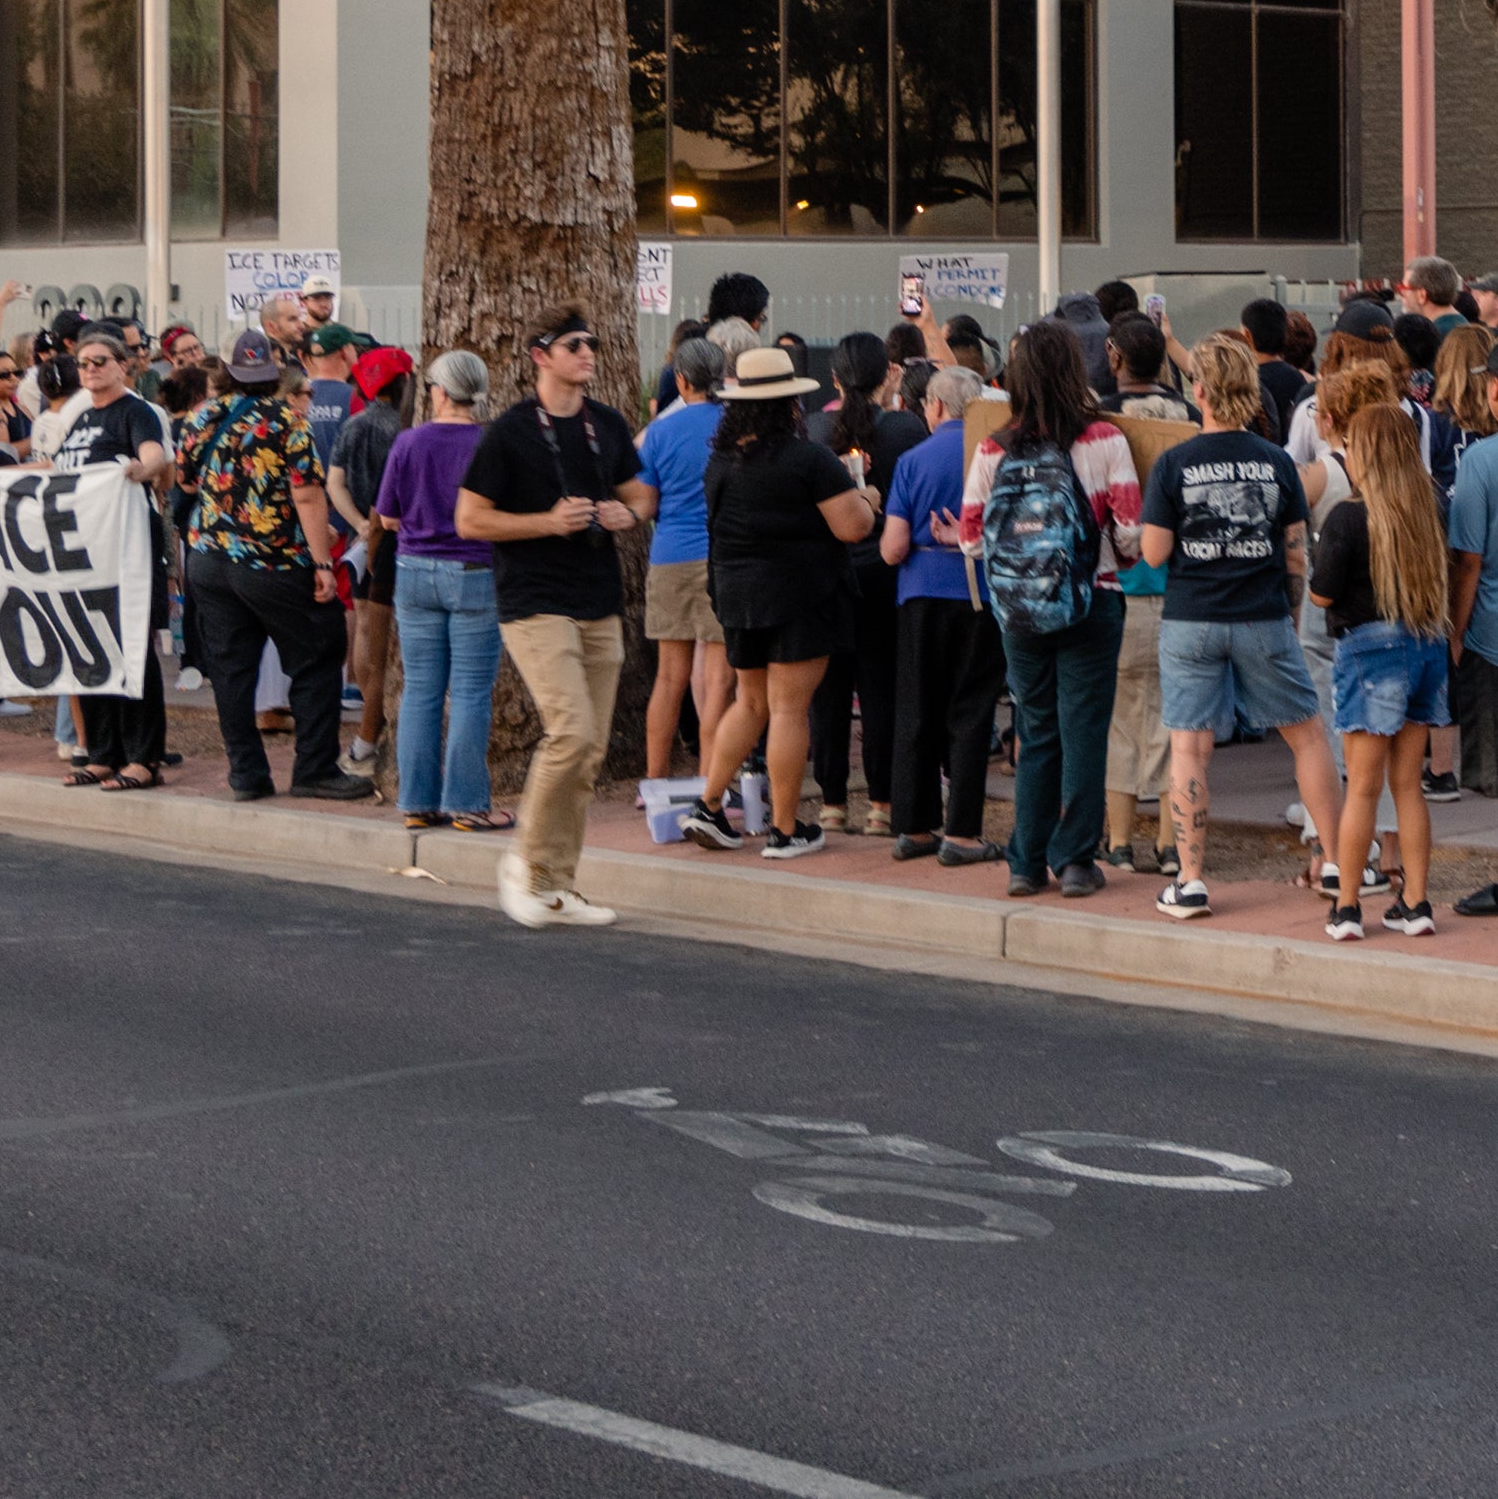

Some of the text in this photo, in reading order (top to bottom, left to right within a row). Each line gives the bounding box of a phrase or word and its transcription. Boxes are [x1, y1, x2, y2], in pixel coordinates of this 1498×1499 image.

[227, 251, 341, 271] ICE TARGETS
[915, 256, 974, 270] WHAT
[936, 267, 1001, 281] PERMIT
[1183, 460, 1275, 485] SMASH YOUR
